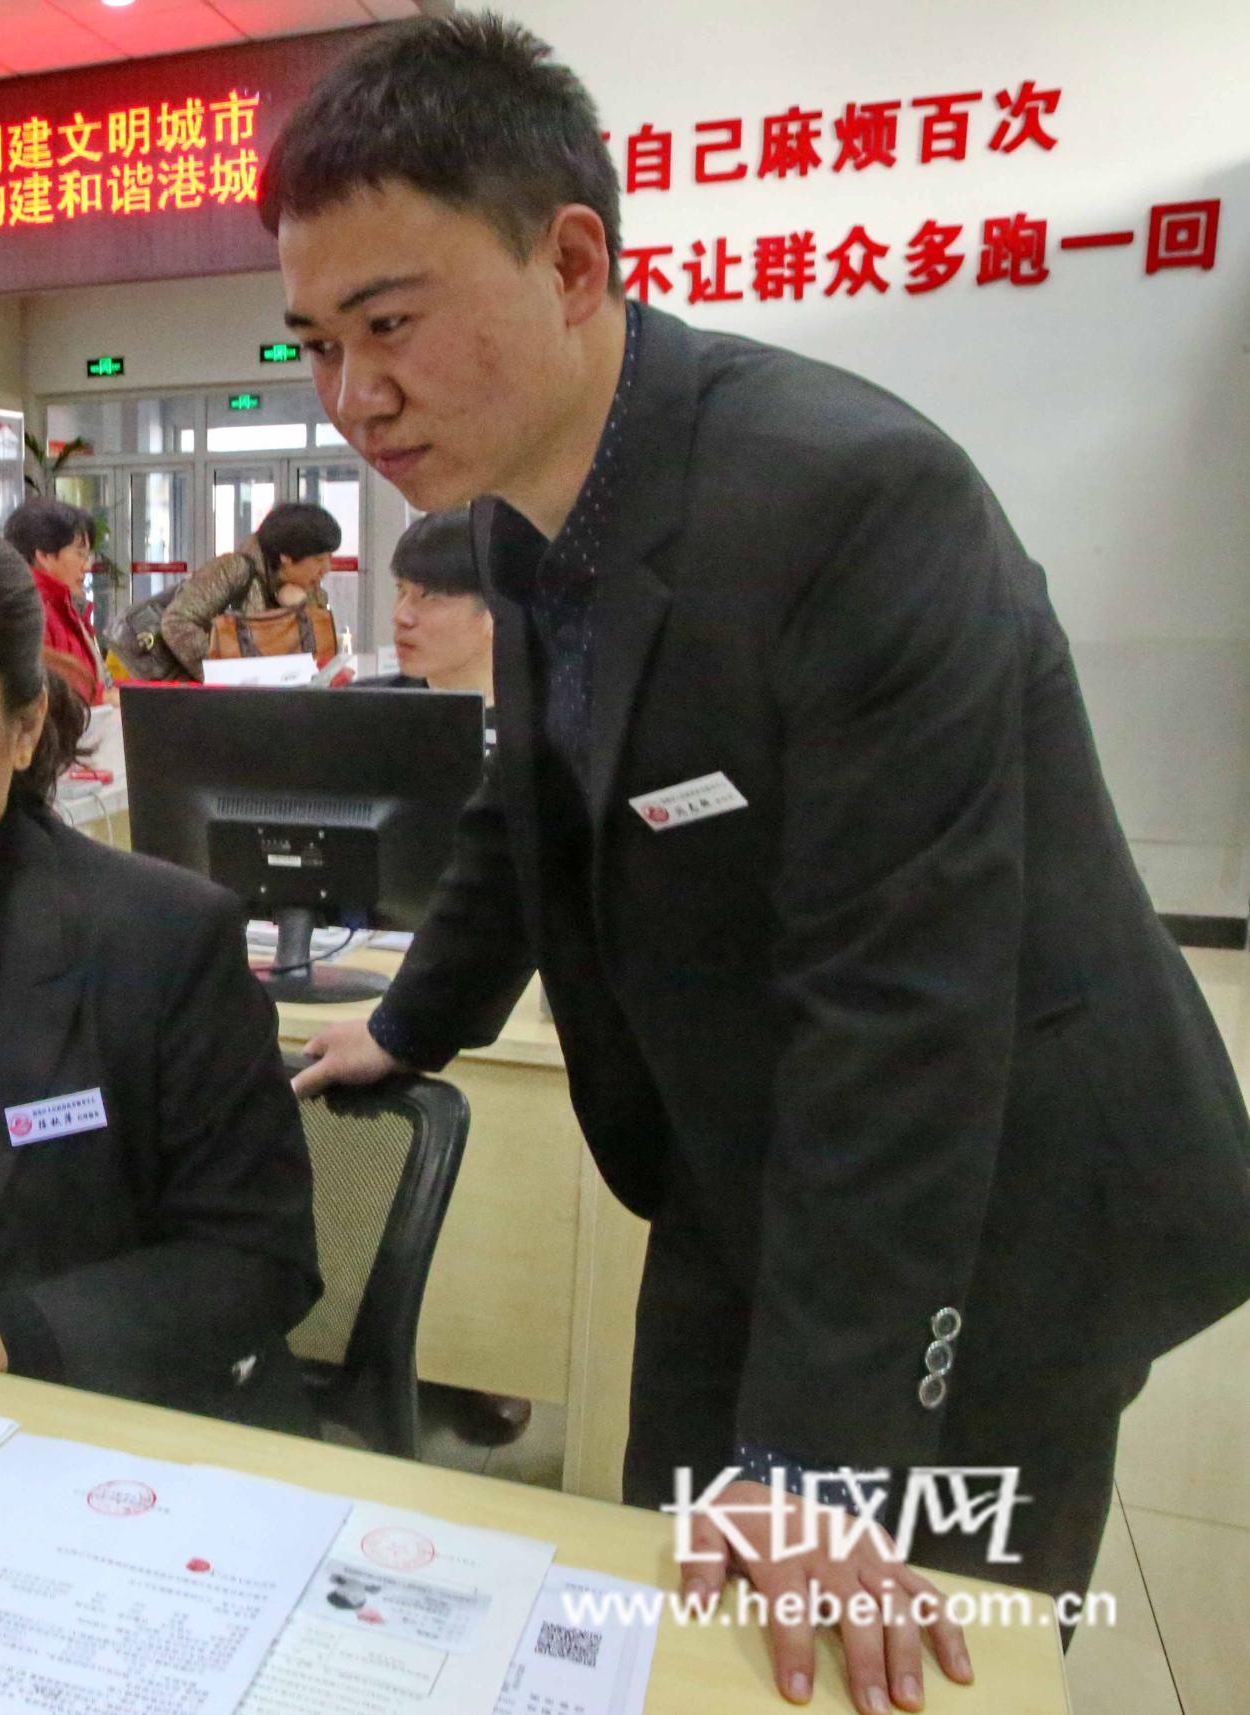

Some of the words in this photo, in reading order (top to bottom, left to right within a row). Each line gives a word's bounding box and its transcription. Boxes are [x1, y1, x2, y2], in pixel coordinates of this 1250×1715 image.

[599, 79, 1062, 193] 自己麻烦百次
[618, 198, 1222, 305] 不让群众多跑一回
